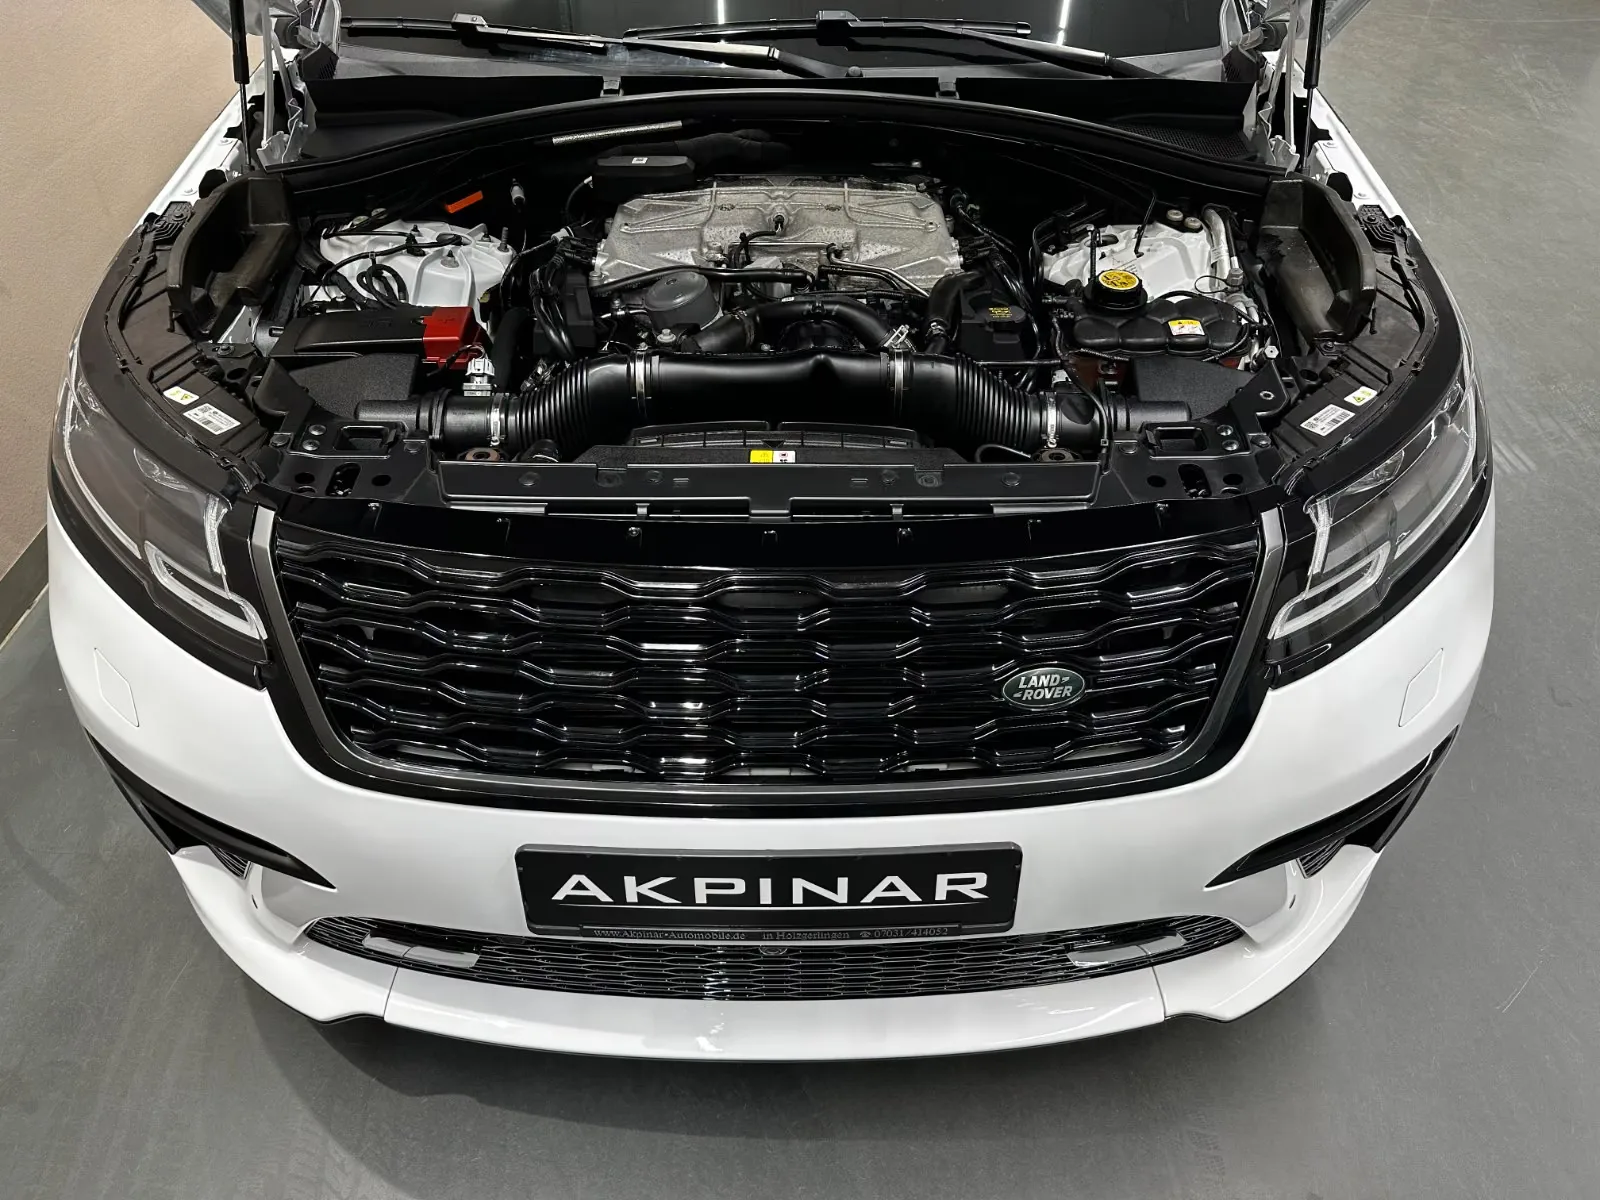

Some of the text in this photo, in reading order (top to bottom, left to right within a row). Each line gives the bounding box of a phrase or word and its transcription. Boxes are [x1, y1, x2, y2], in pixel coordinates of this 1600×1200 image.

[1018, 674, 1061, 688] LAND
[1021, 685, 1073, 700] ROVER
[551, 872, 990, 904] AKPINAR
[762, 931, 773, 940] in
[775, 931, 850, 941] Holzgerlingen
